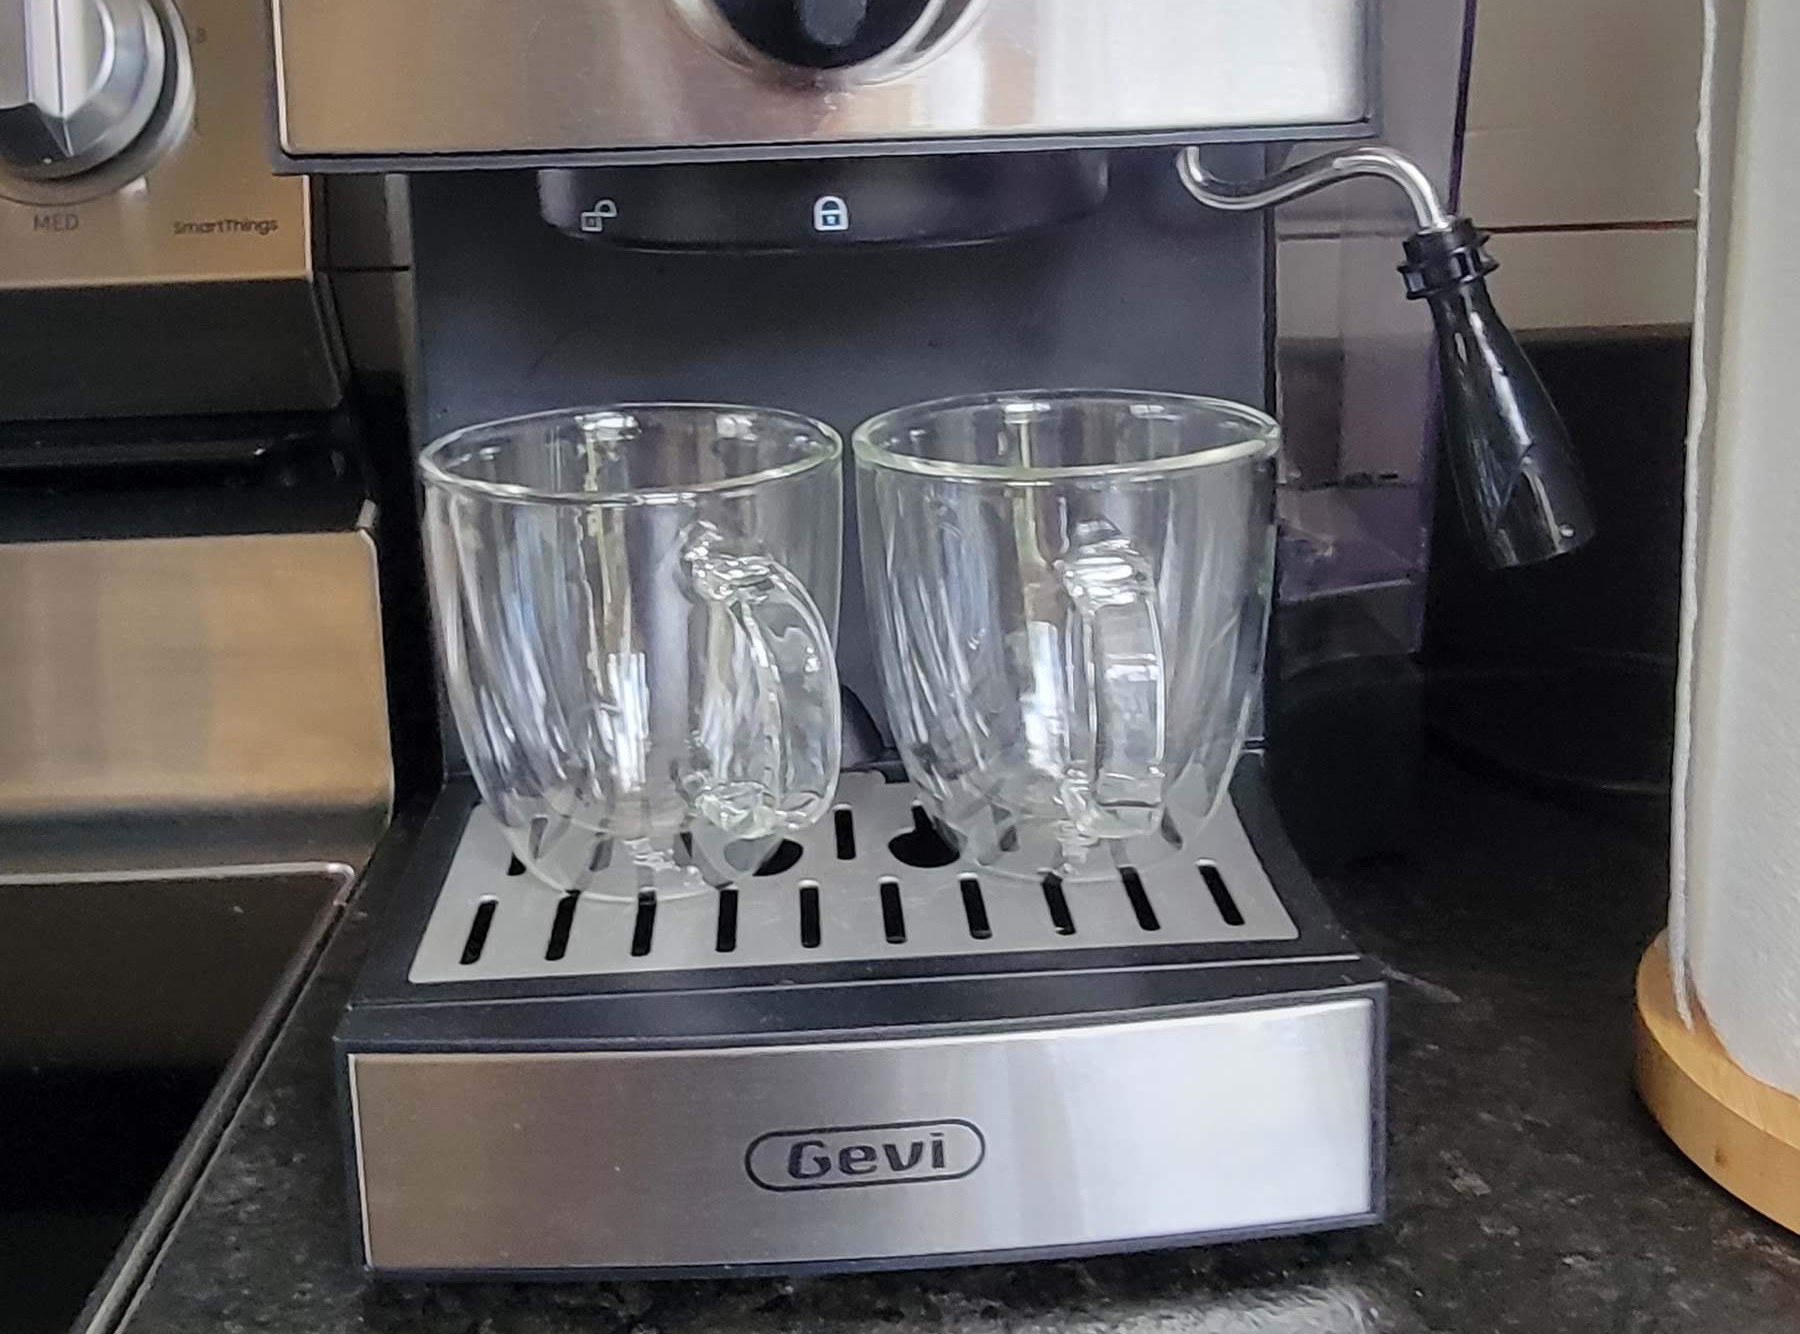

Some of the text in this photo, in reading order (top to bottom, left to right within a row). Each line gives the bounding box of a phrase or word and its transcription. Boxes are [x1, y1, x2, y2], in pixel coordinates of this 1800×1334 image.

[33, 213, 80, 234] MED
[172, 216, 279, 236] SmartThings
[787, 1131, 946, 1180] Gevi
